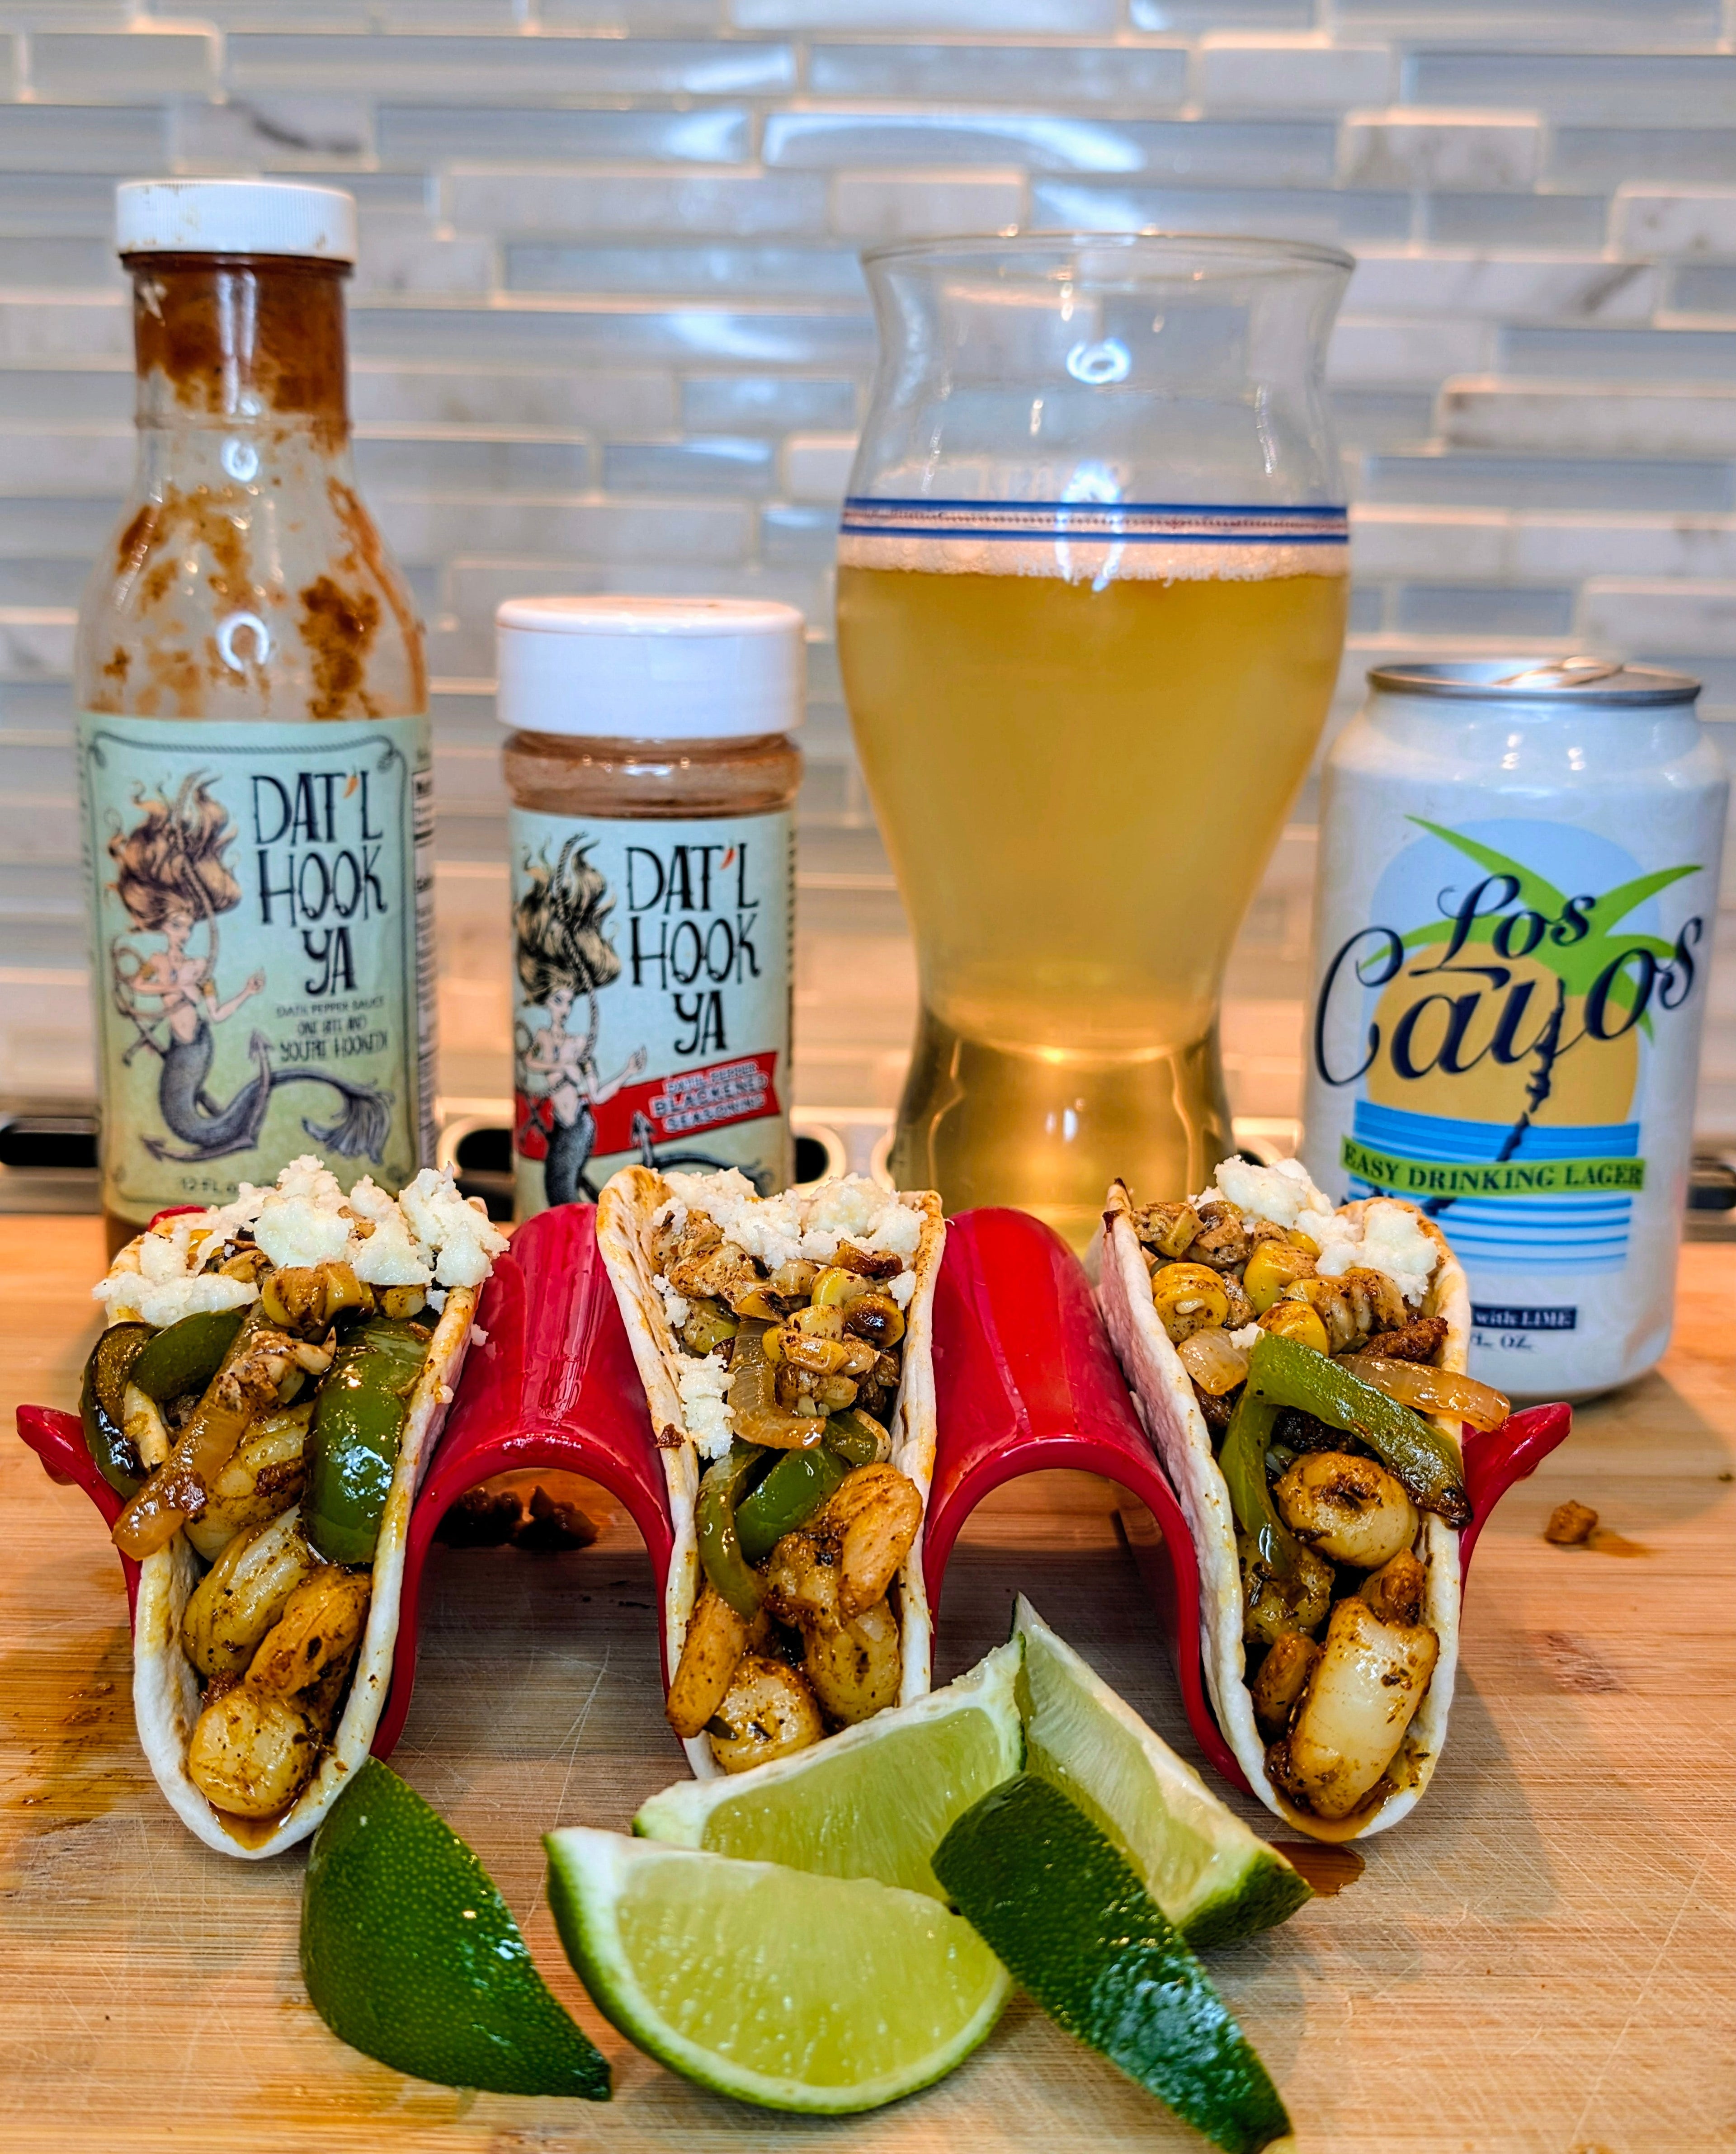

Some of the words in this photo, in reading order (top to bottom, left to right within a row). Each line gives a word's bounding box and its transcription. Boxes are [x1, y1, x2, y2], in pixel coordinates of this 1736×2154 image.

[251, 768, 383, 846] DAT'L
[258, 846, 387, 927] HOOK
[625, 841, 760, 914] DAT'L
[302, 927, 358, 996] YA
[630, 914, 761, 990] HOOK
[1409, 873, 1595, 990] Los
[312, 1000, 347, 1013] PEPPER
[352, 996, 384, 1010] SAUCE
[673, 991, 726, 1055] YA
[654, 1074, 765, 1116] BLACKENED
[710, 1062, 755, 1083] PEPPER
[666, 1093, 764, 1128] SEASONING
[1344, 1143, 1399, 1183] EASY
[1408, 1164, 1555, 1192] DRINKING
[1565, 1162, 1644, 1186] LAGER
[1475, 1310, 1517, 1325] with
[1522, 1311, 1572, 1327] LIME
